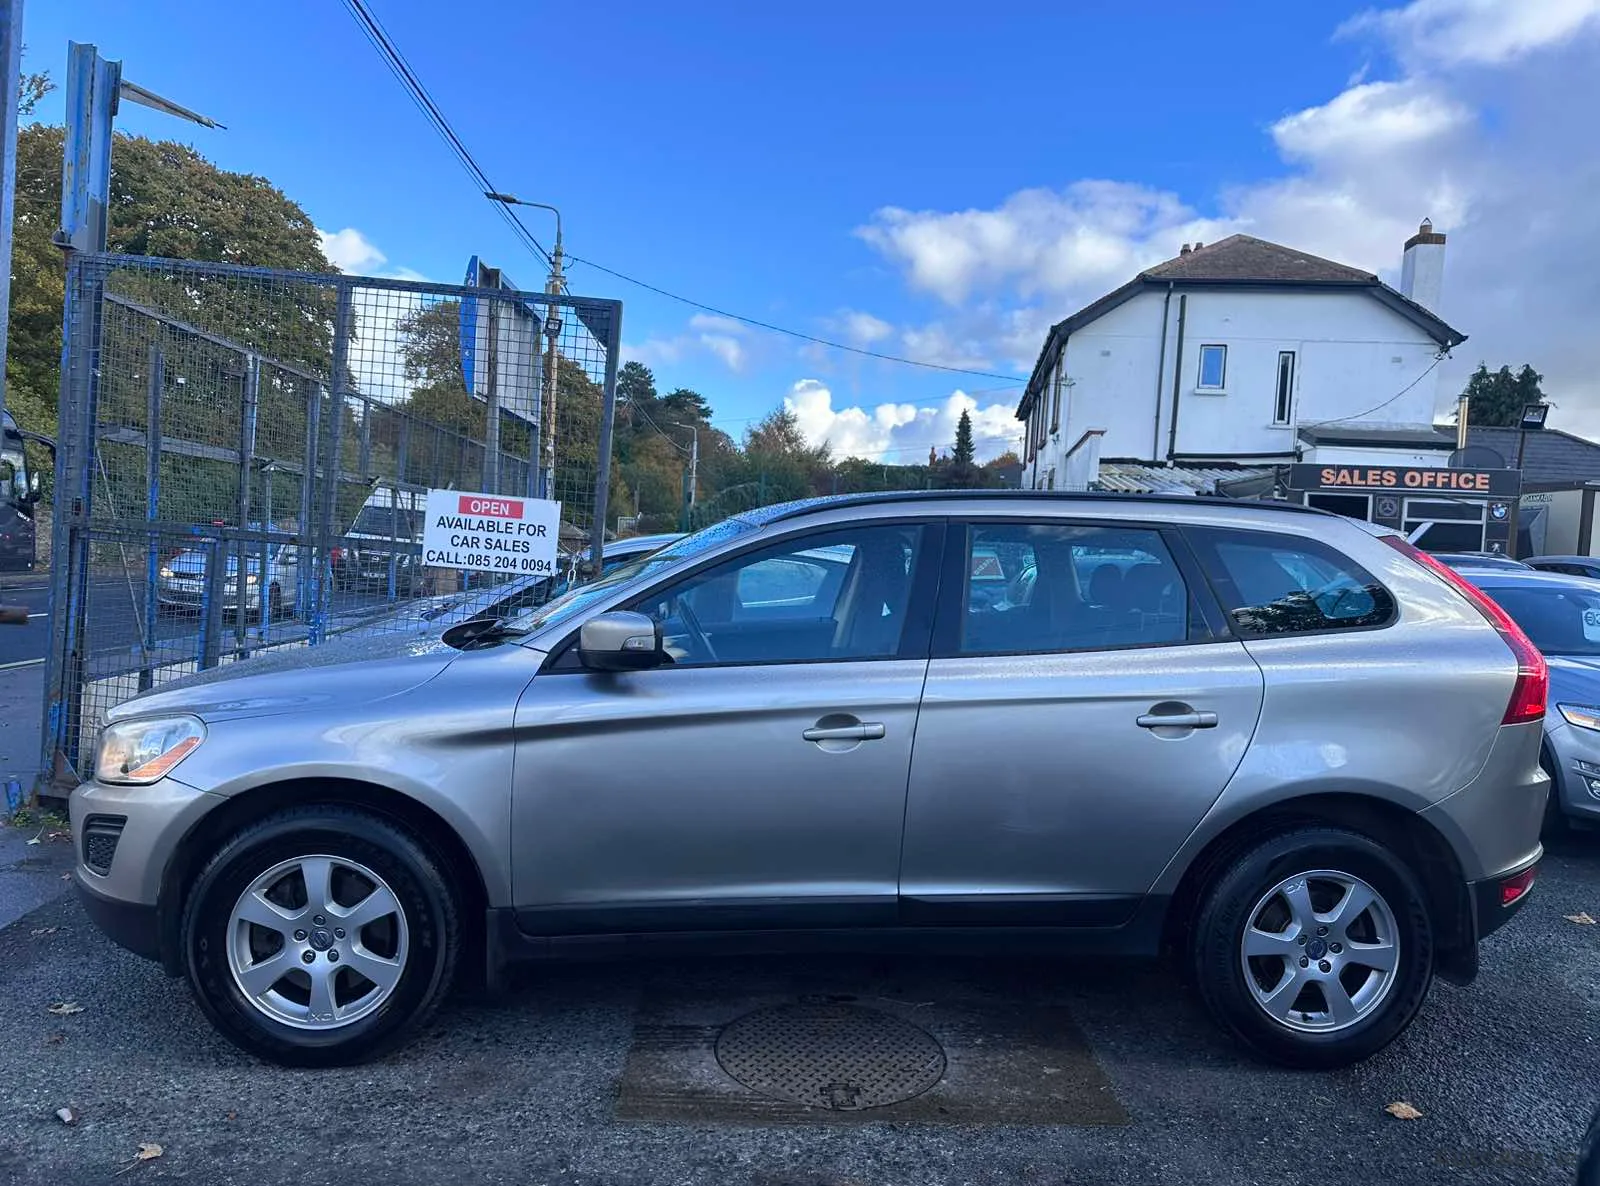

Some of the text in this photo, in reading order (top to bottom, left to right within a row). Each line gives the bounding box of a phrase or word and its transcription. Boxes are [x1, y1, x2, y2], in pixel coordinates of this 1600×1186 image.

[1320, 468, 1490, 489] SALES OFFICE
[470, 500, 509, 516] OPEN
[436, 515, 547, 537] AVAILABLE FOR
[450, 535, 530, 553] CAR SALES
[426, 550, 552, 573] CALL:085 204 0094
